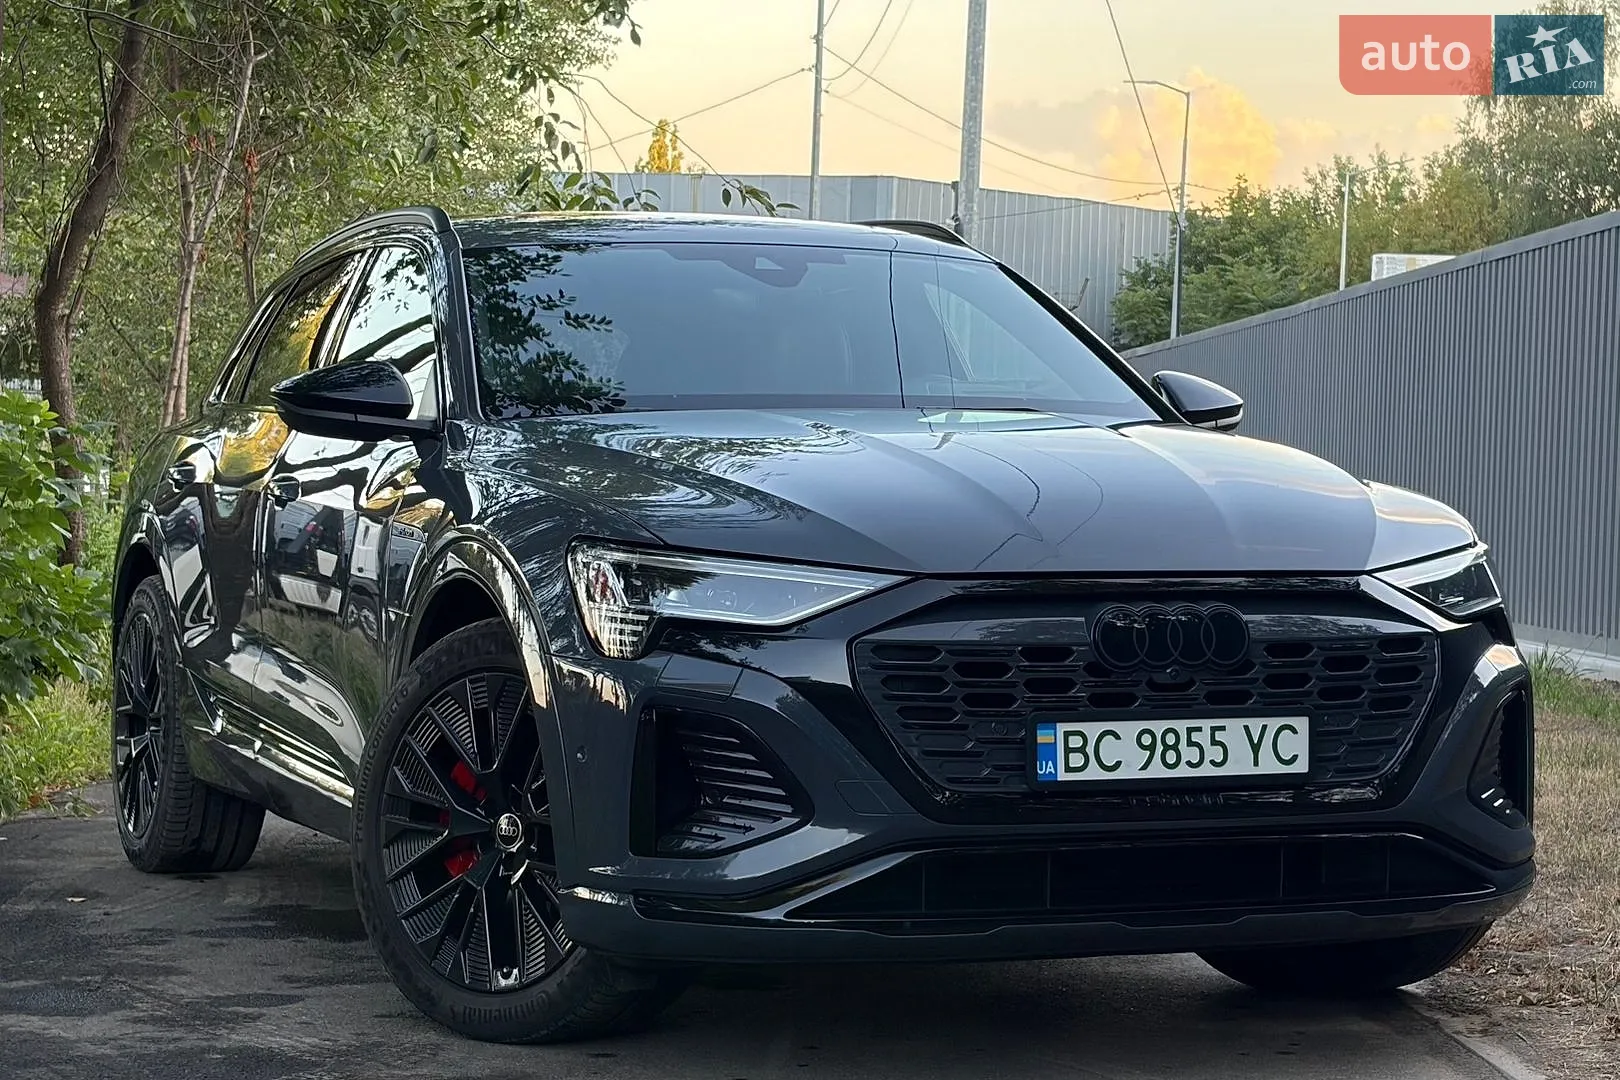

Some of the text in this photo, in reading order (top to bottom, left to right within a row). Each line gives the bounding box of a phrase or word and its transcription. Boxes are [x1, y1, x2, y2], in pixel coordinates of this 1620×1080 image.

[1062, 723, 1299, 774] BC 9855 YC
[1037, 761, 1055, 775] UA
